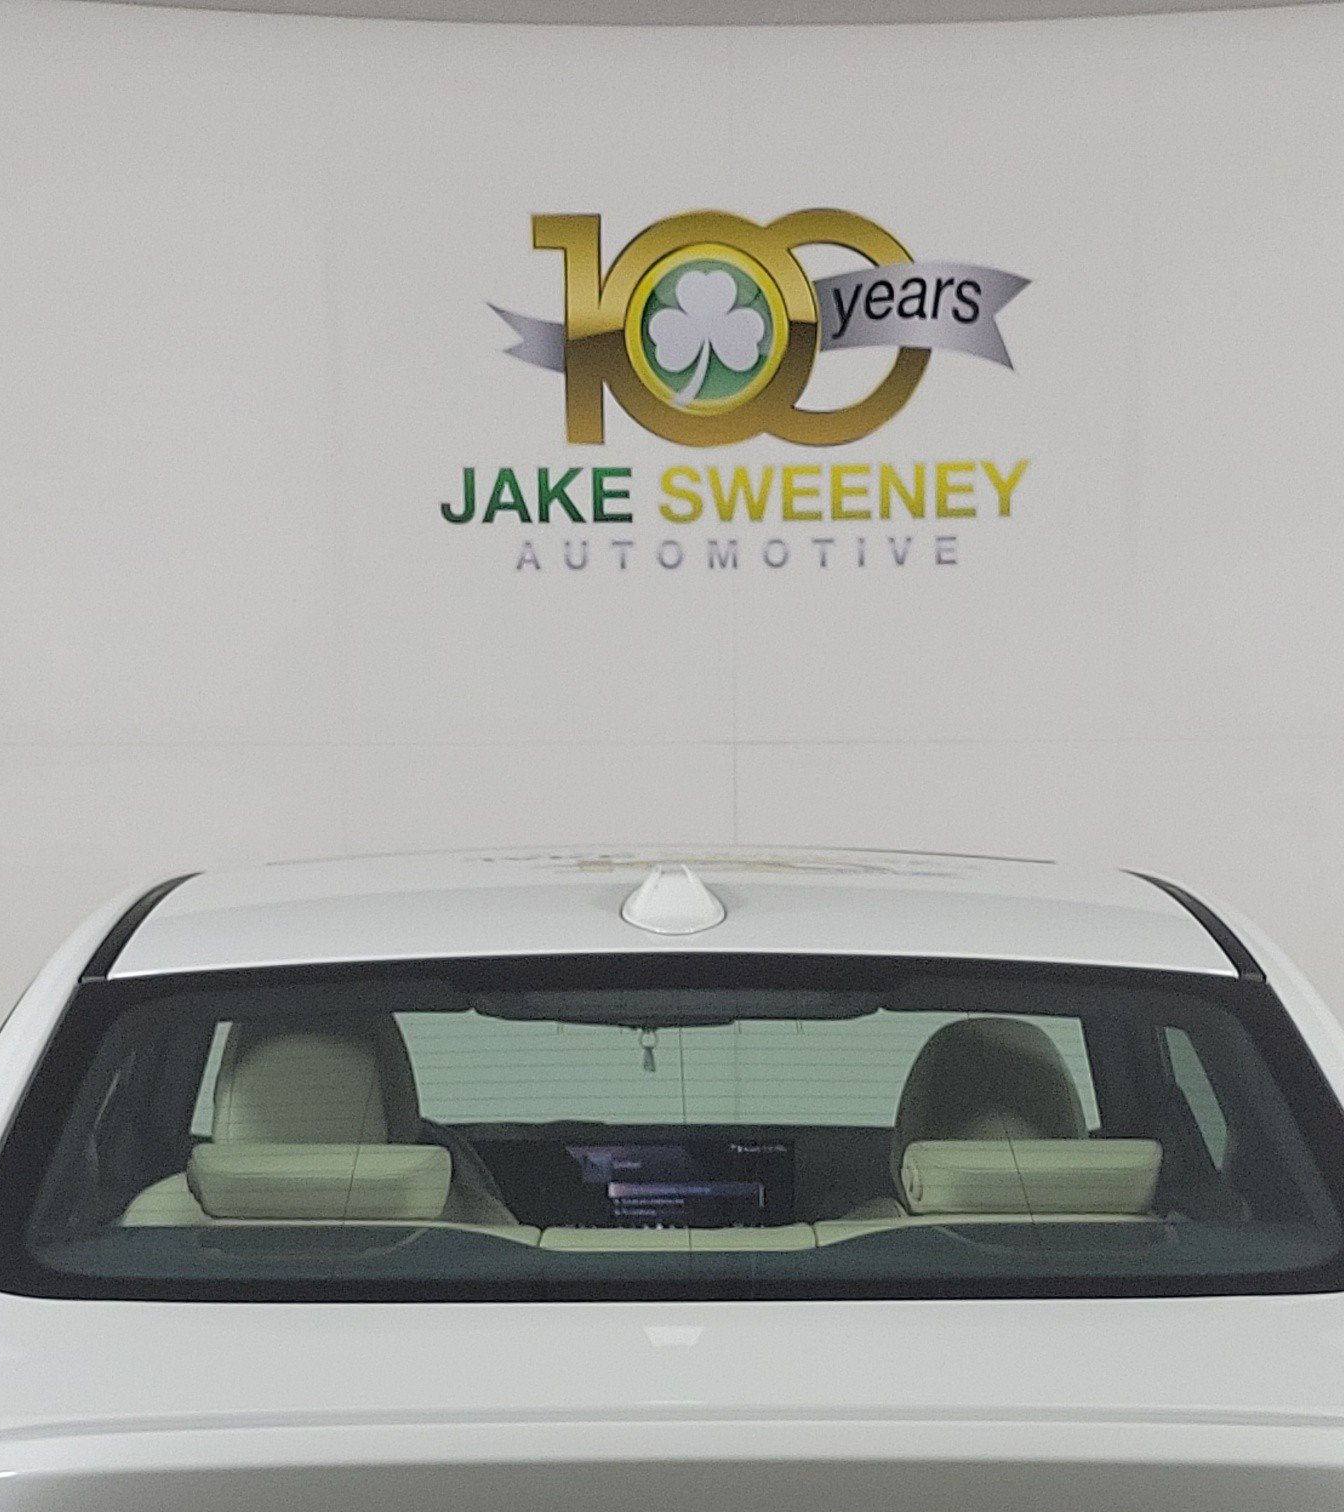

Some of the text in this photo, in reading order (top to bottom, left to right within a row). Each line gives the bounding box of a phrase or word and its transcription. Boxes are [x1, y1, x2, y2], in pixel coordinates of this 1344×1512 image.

[831, 276, 983, 339] years
[440, 460, 1030, 525] JAKE SWEENEY
[516, 536, 958, 571] AUTOMOTIVE
